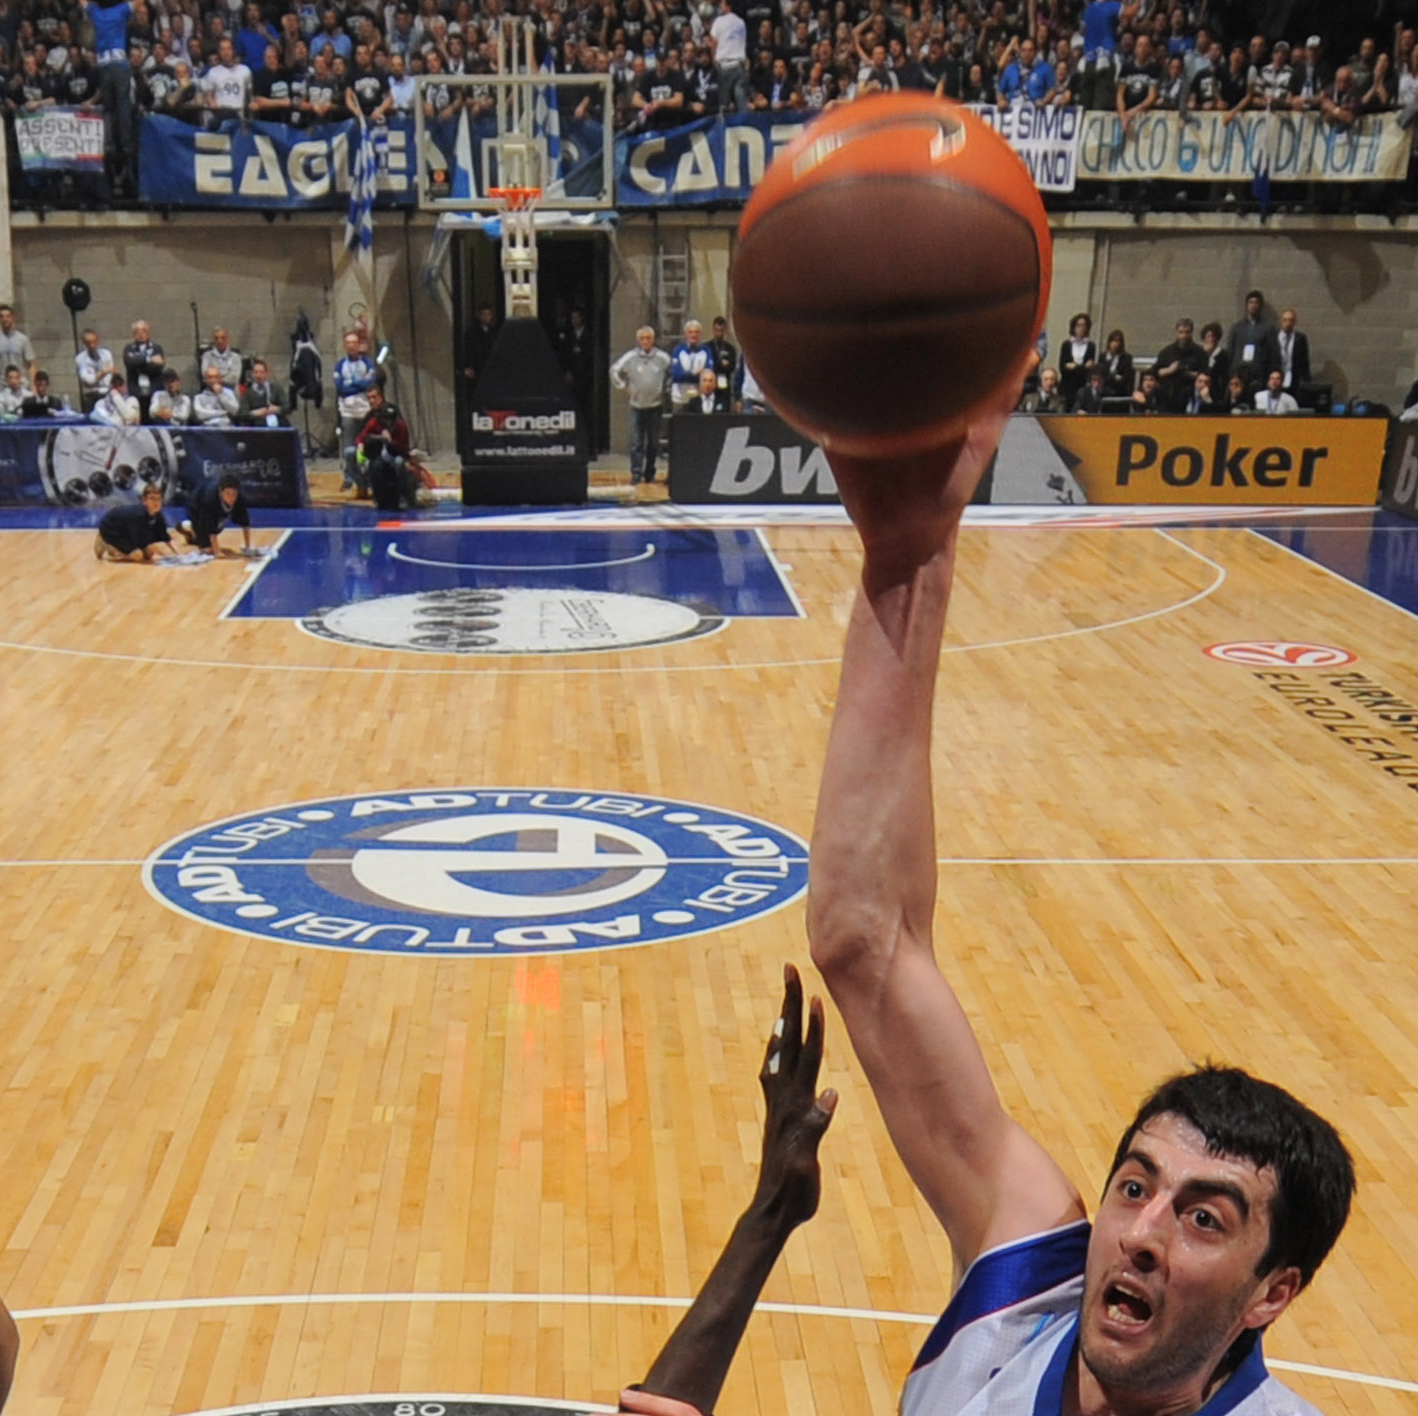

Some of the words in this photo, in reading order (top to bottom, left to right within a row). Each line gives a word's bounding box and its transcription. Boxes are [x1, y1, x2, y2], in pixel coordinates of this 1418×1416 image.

[1017, 105, 1077, 141] SIMO
[1275, 115, 1304, 173] DI
[1041, 150, 1072, 185] NOI
[708, 426, 837, 496] bw
[1115, 433, 1328, 489] Poker
[349, 789, 666, 819] ADTUBI
